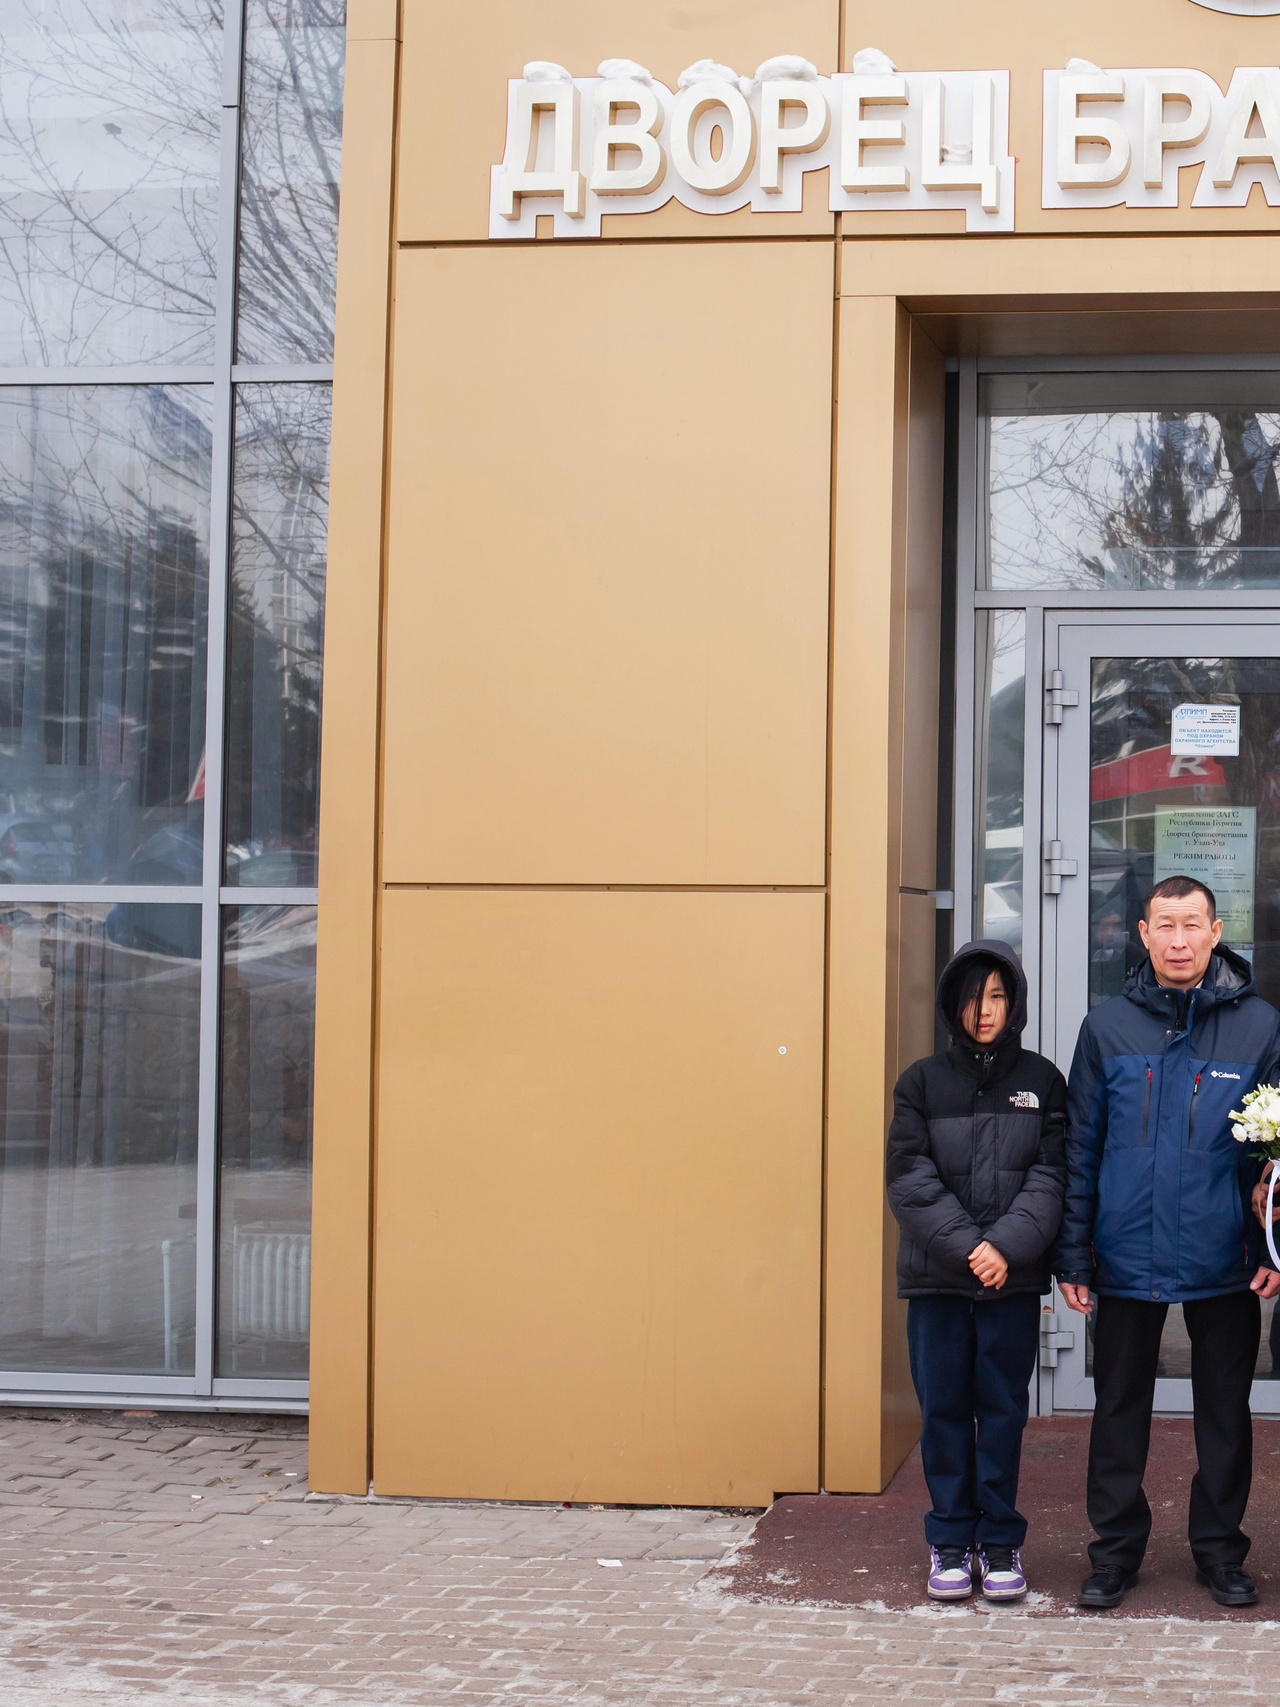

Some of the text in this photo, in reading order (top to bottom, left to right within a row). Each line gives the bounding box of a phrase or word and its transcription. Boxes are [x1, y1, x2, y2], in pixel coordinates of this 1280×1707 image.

[497, 74, 1002, 222] ДВОРЕЦ
[1168, 818, 1242, 828] Республики Бурятия
[1162, 830, 1190, 838] Дворец
[1204, 853, 1236, 861] РАБОТЫ
